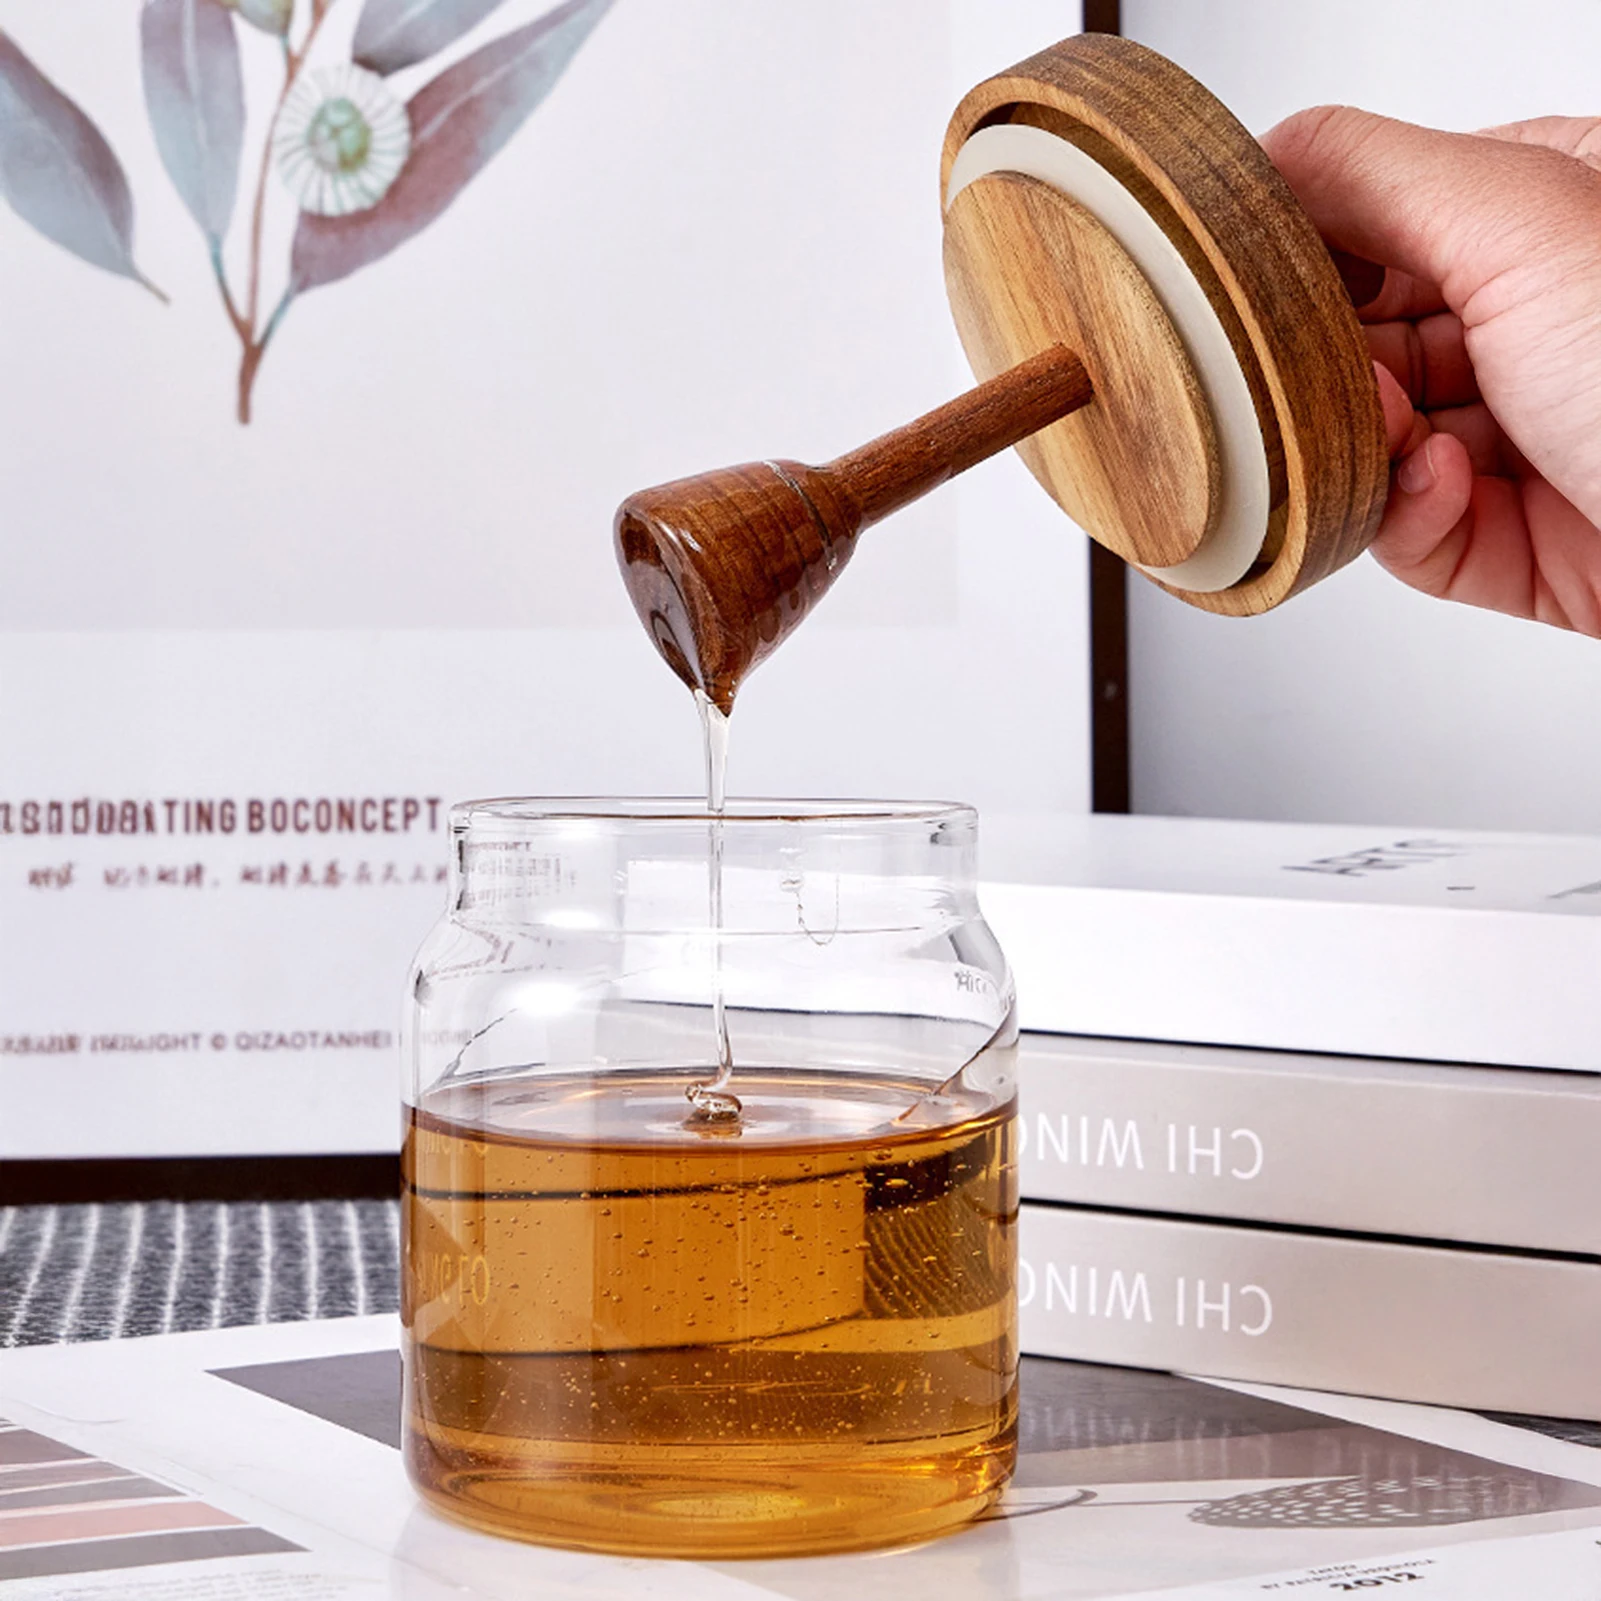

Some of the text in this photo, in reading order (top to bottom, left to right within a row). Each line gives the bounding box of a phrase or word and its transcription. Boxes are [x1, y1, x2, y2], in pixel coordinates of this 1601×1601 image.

[246, 797, 442, 835] BOCONCEPT
[1168, 1124, 1264, 1180] CHI
[1176, 1276, 1273, 1336] CHI
[1329, 1571, 1424, 1591] 2012
